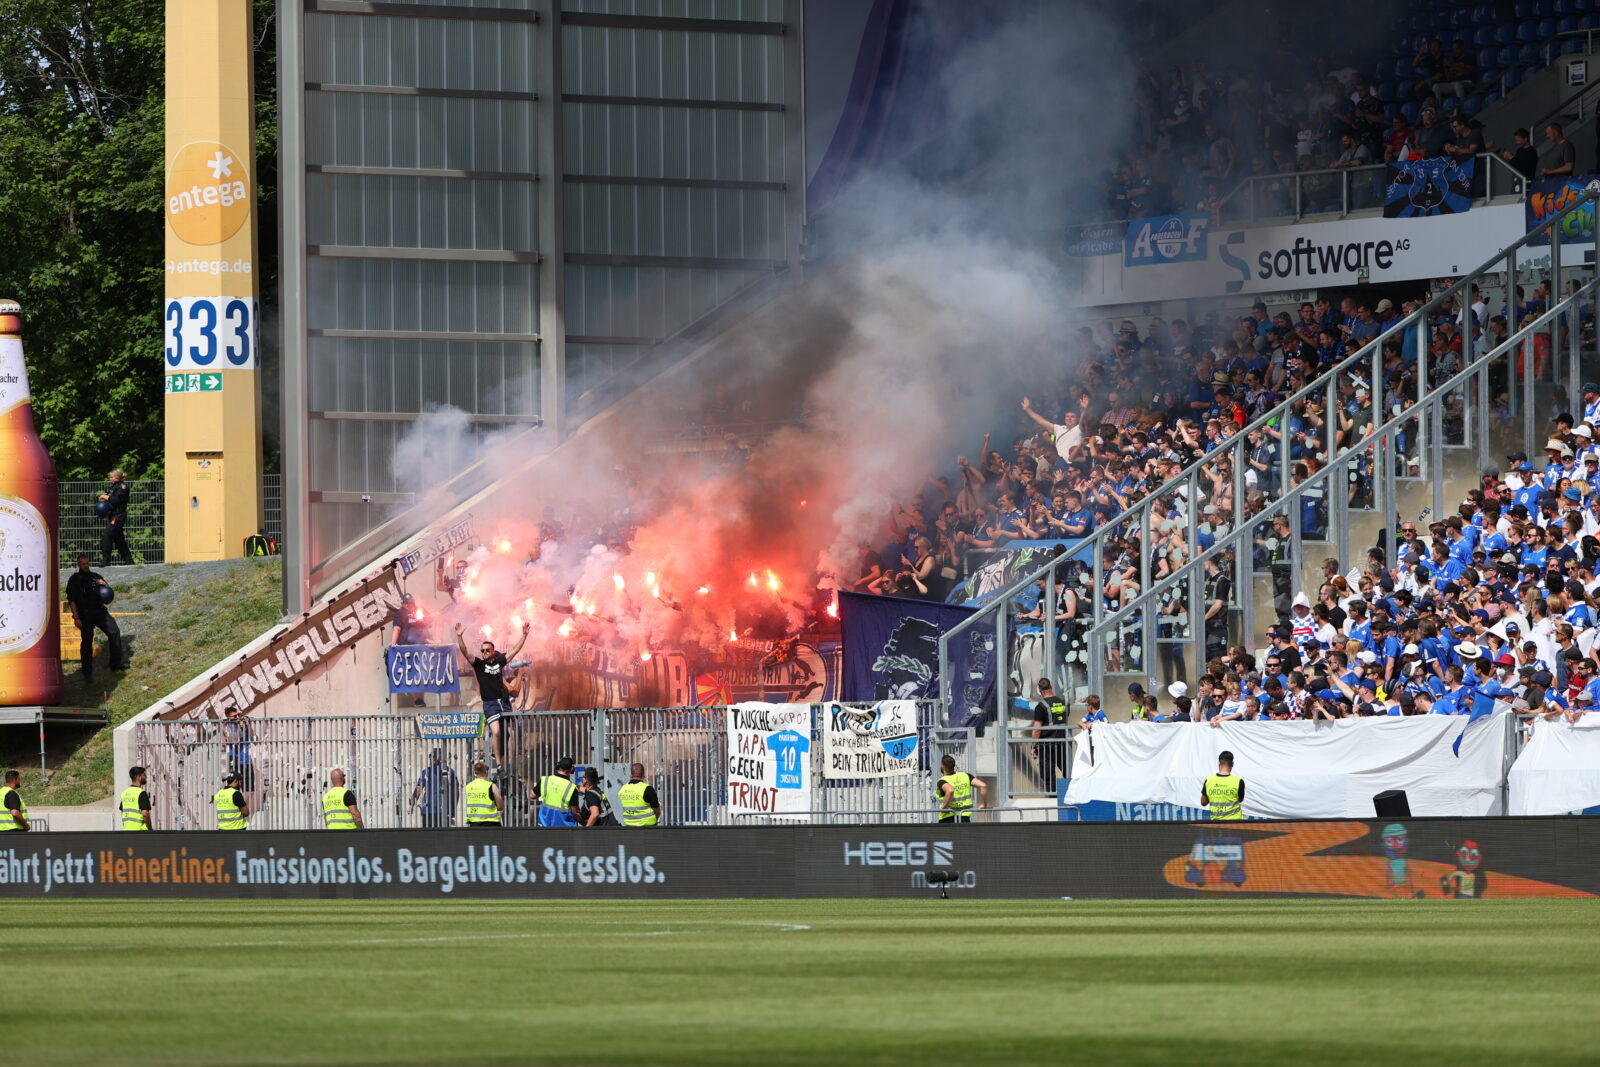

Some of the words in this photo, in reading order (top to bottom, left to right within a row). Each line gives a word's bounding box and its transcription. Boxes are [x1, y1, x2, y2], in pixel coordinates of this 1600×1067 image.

[169, 179, 246, 215] entega
[1132, 222, 1154, 258] A
[1185, 218, 1209, 253] F
[177, 258, 251, 276] entega.de
[1258, 237, 1394, 280] software
[1395, 239, 1410, 251] AG
[392, 651, 457, 686] GESSELN
[419, 714, 451, 724] SCHNAPS
[460, 713, 480, 723] WEED
[731, 708, 772, 731] TAUSCHE
[738, 732, 766, 757] PAPA
[729, 756, 764, 781] GEGEN
[780, 746, 796, 772] 10
[832, 754, 851, 773] DEIN
[855, 751, 887, 774] TRIKOT
[729, 782, 778, 813] TRIKOT
[1208, 788, 1235, 796] ORDNER
[45, 848, 94, 893] jetzt
[99, 847, 231, 884] HeinerLiner.
[236, 846, 392, 884] Emissionslos.
[397, 845, 536, 893] Bargeldlos.
[543, 845, 665, 884] Stresslos.
